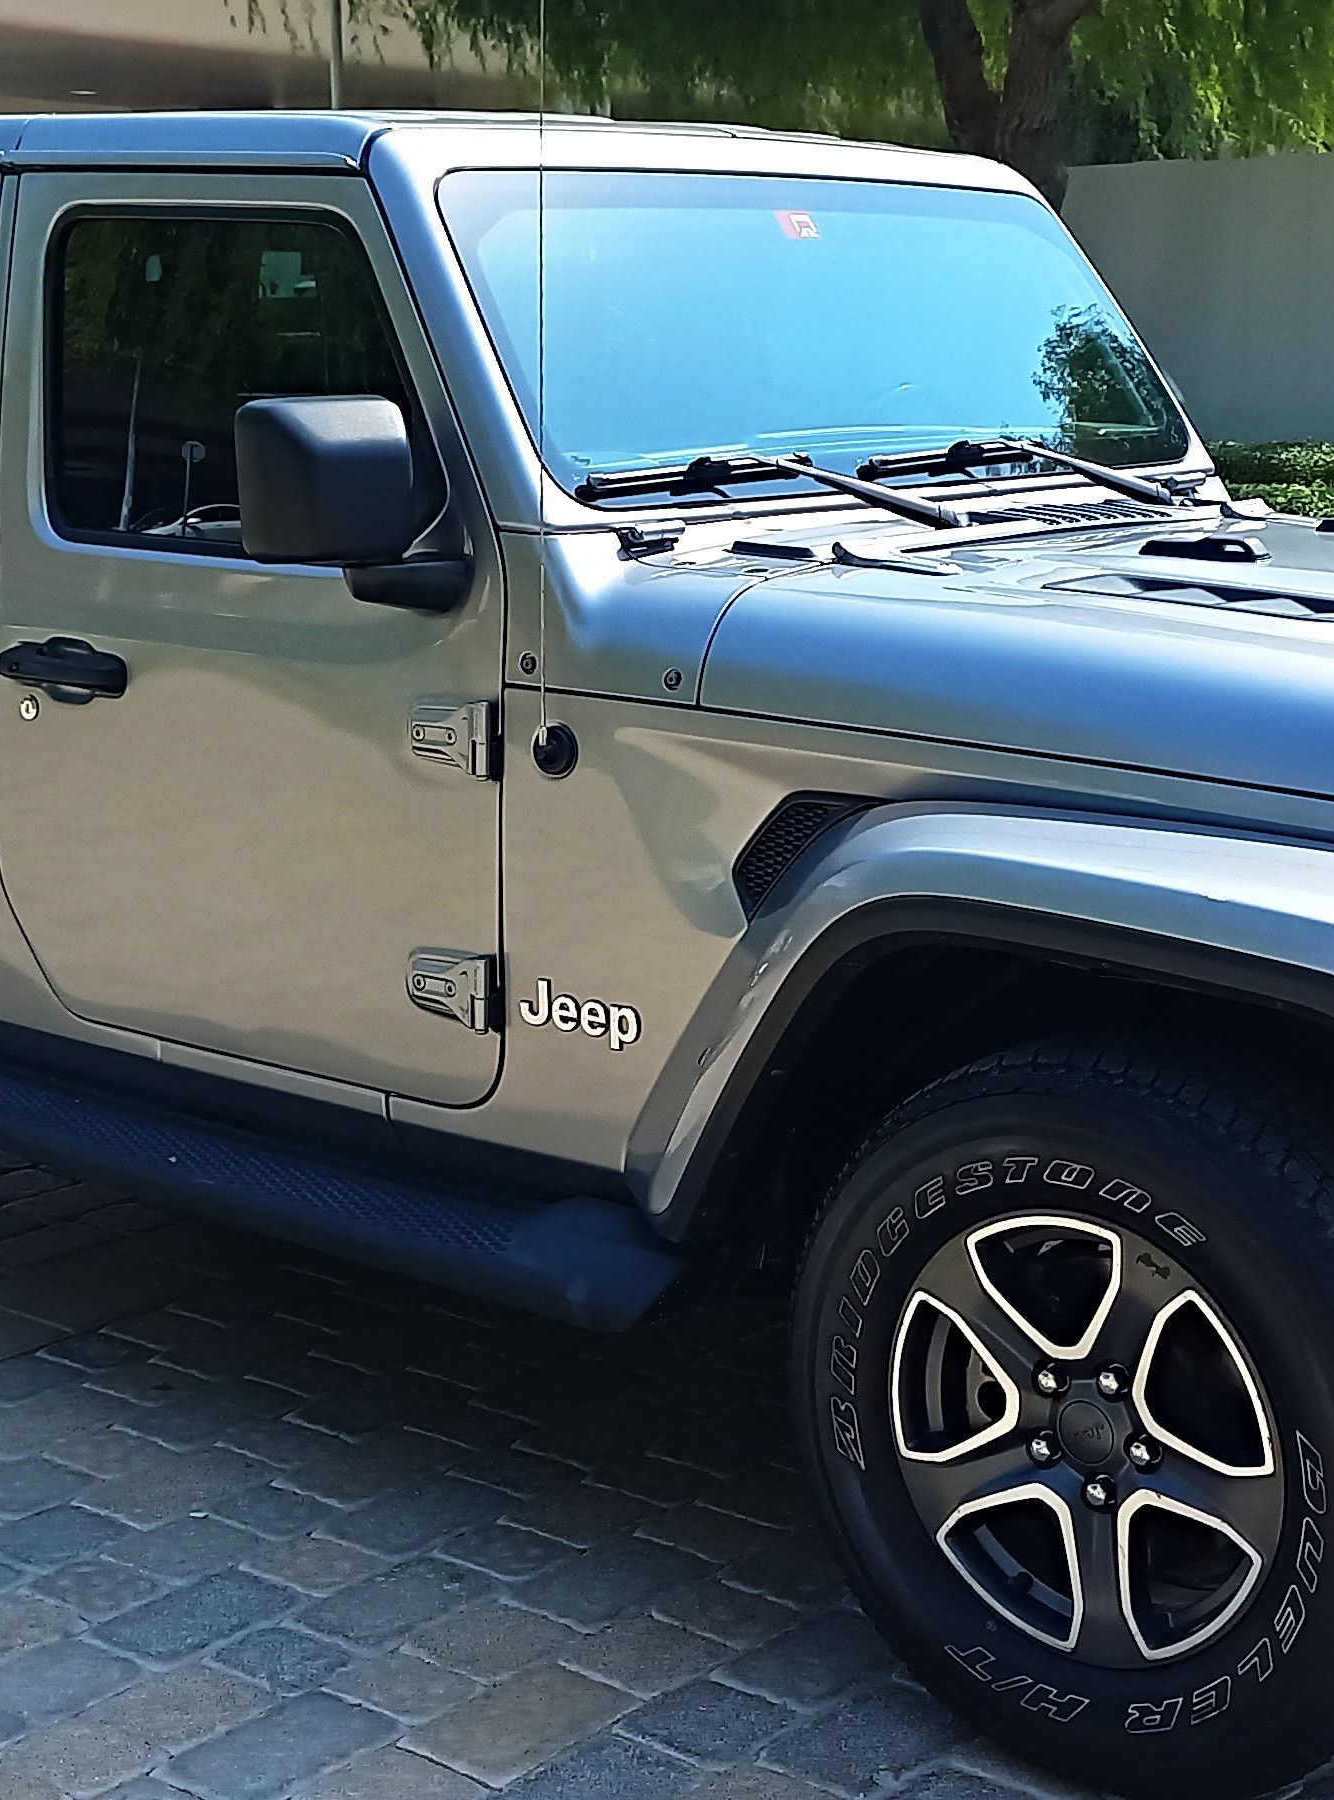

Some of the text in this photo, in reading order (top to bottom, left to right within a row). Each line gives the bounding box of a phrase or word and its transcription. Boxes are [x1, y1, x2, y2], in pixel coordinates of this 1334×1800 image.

[519, 977, 642, 1051] Jeep
[829, 1155, 1207, 1471] BRIDGESTONE
[944, 1429, 1328, 1735] DUELER H/T
